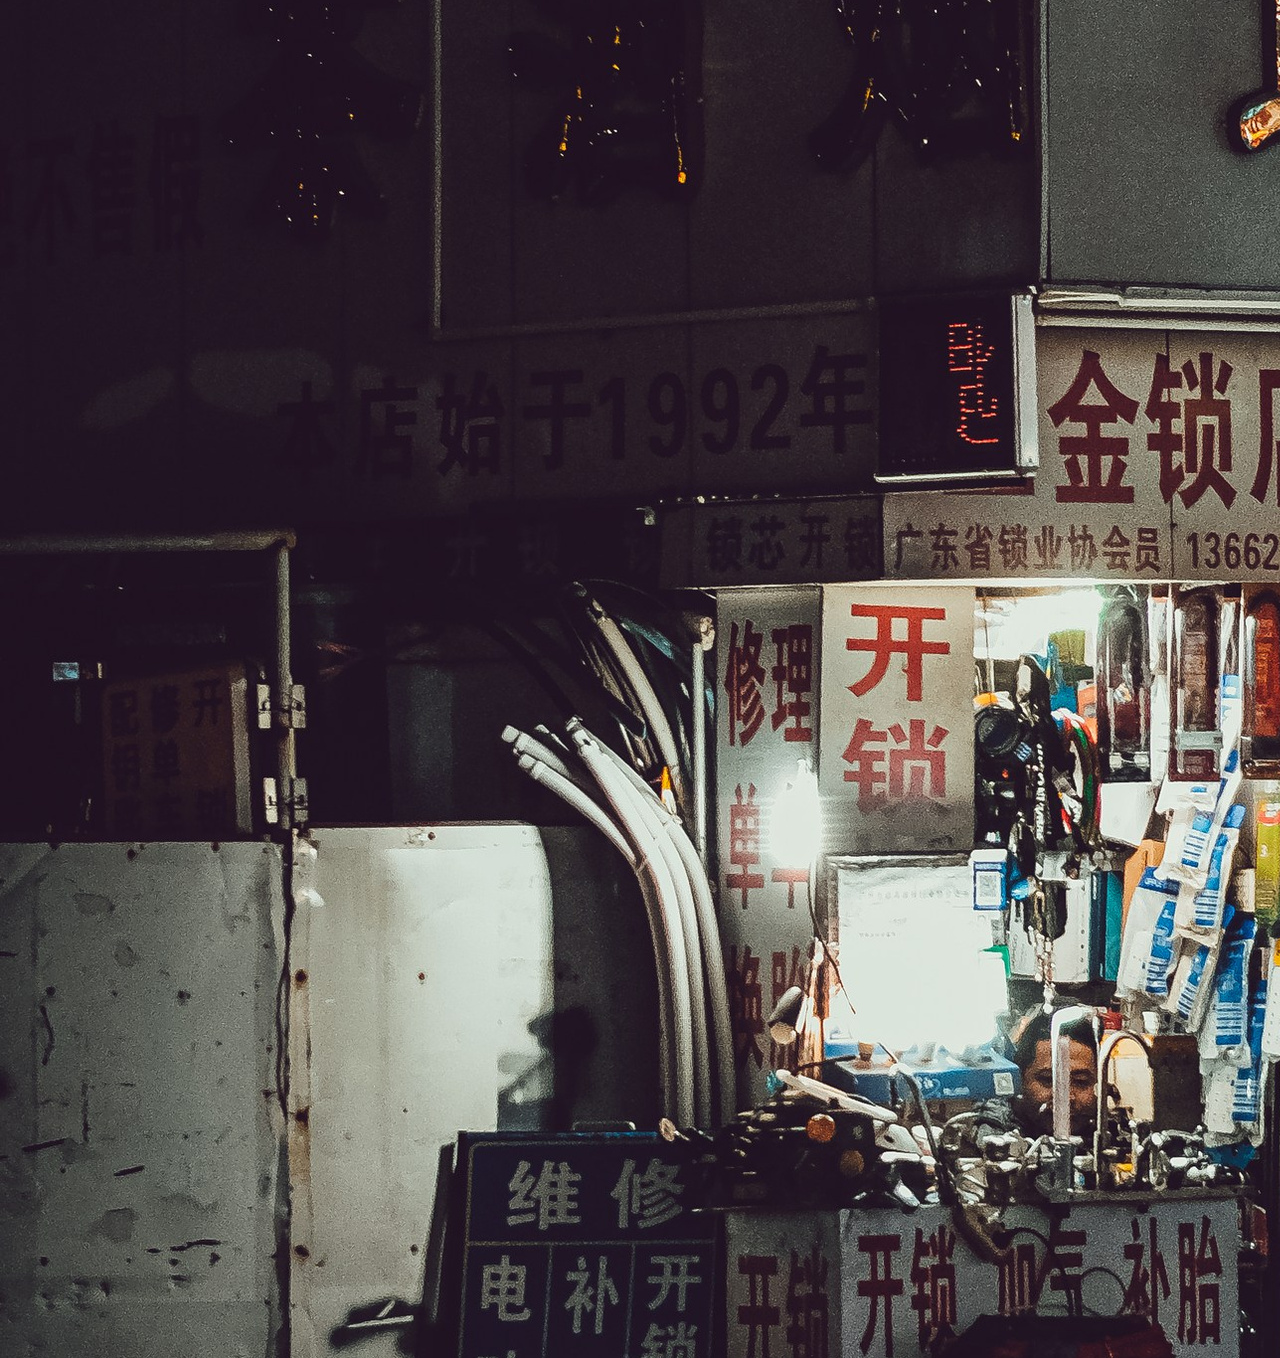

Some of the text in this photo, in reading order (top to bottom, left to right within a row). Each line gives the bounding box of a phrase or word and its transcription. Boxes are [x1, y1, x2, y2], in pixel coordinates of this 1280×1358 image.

[275, 347, 872, 482] 本店始于1992年
[895, 522, 1161, 574] 广东省锁业协会员
[724, 619, 813, 747] 修理
[842, 603, 950, 813] 开锁
[506, 1156, 686, 1231] 维修
[856, 1224, 958, 1358] 开锁
[1123, 1214, 1223, 1345] 补胎
